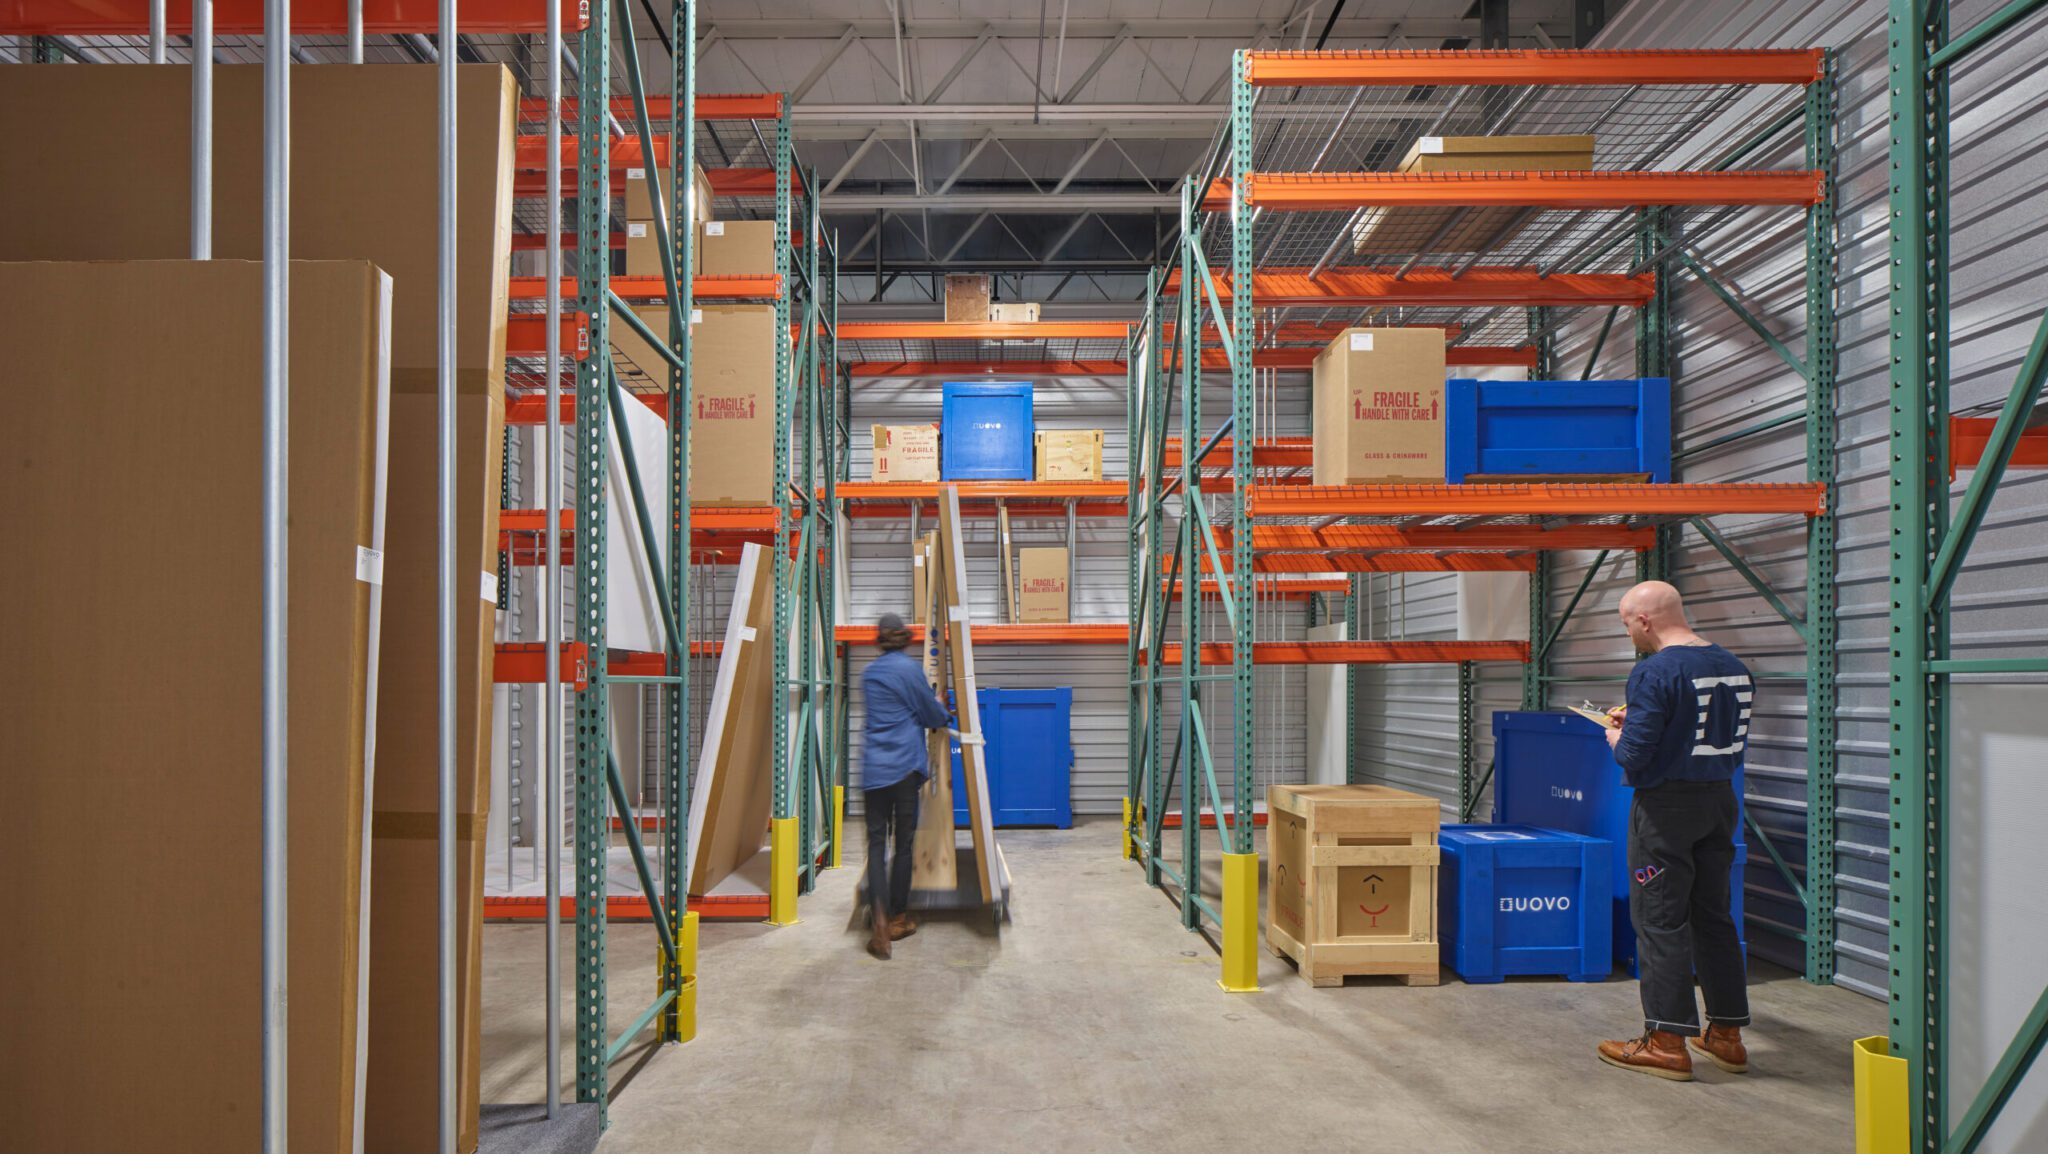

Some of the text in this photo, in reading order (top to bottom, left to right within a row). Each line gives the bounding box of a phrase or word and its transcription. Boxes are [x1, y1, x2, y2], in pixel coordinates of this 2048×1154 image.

[709, 397, 745, 411] FRAGILE
[1373, 391, 1420, 408] FRAGILE
[1362, 408, 1430, 421] HANDLE WITH CARE
[1032, 578, 1056, 587] FRAGILE
